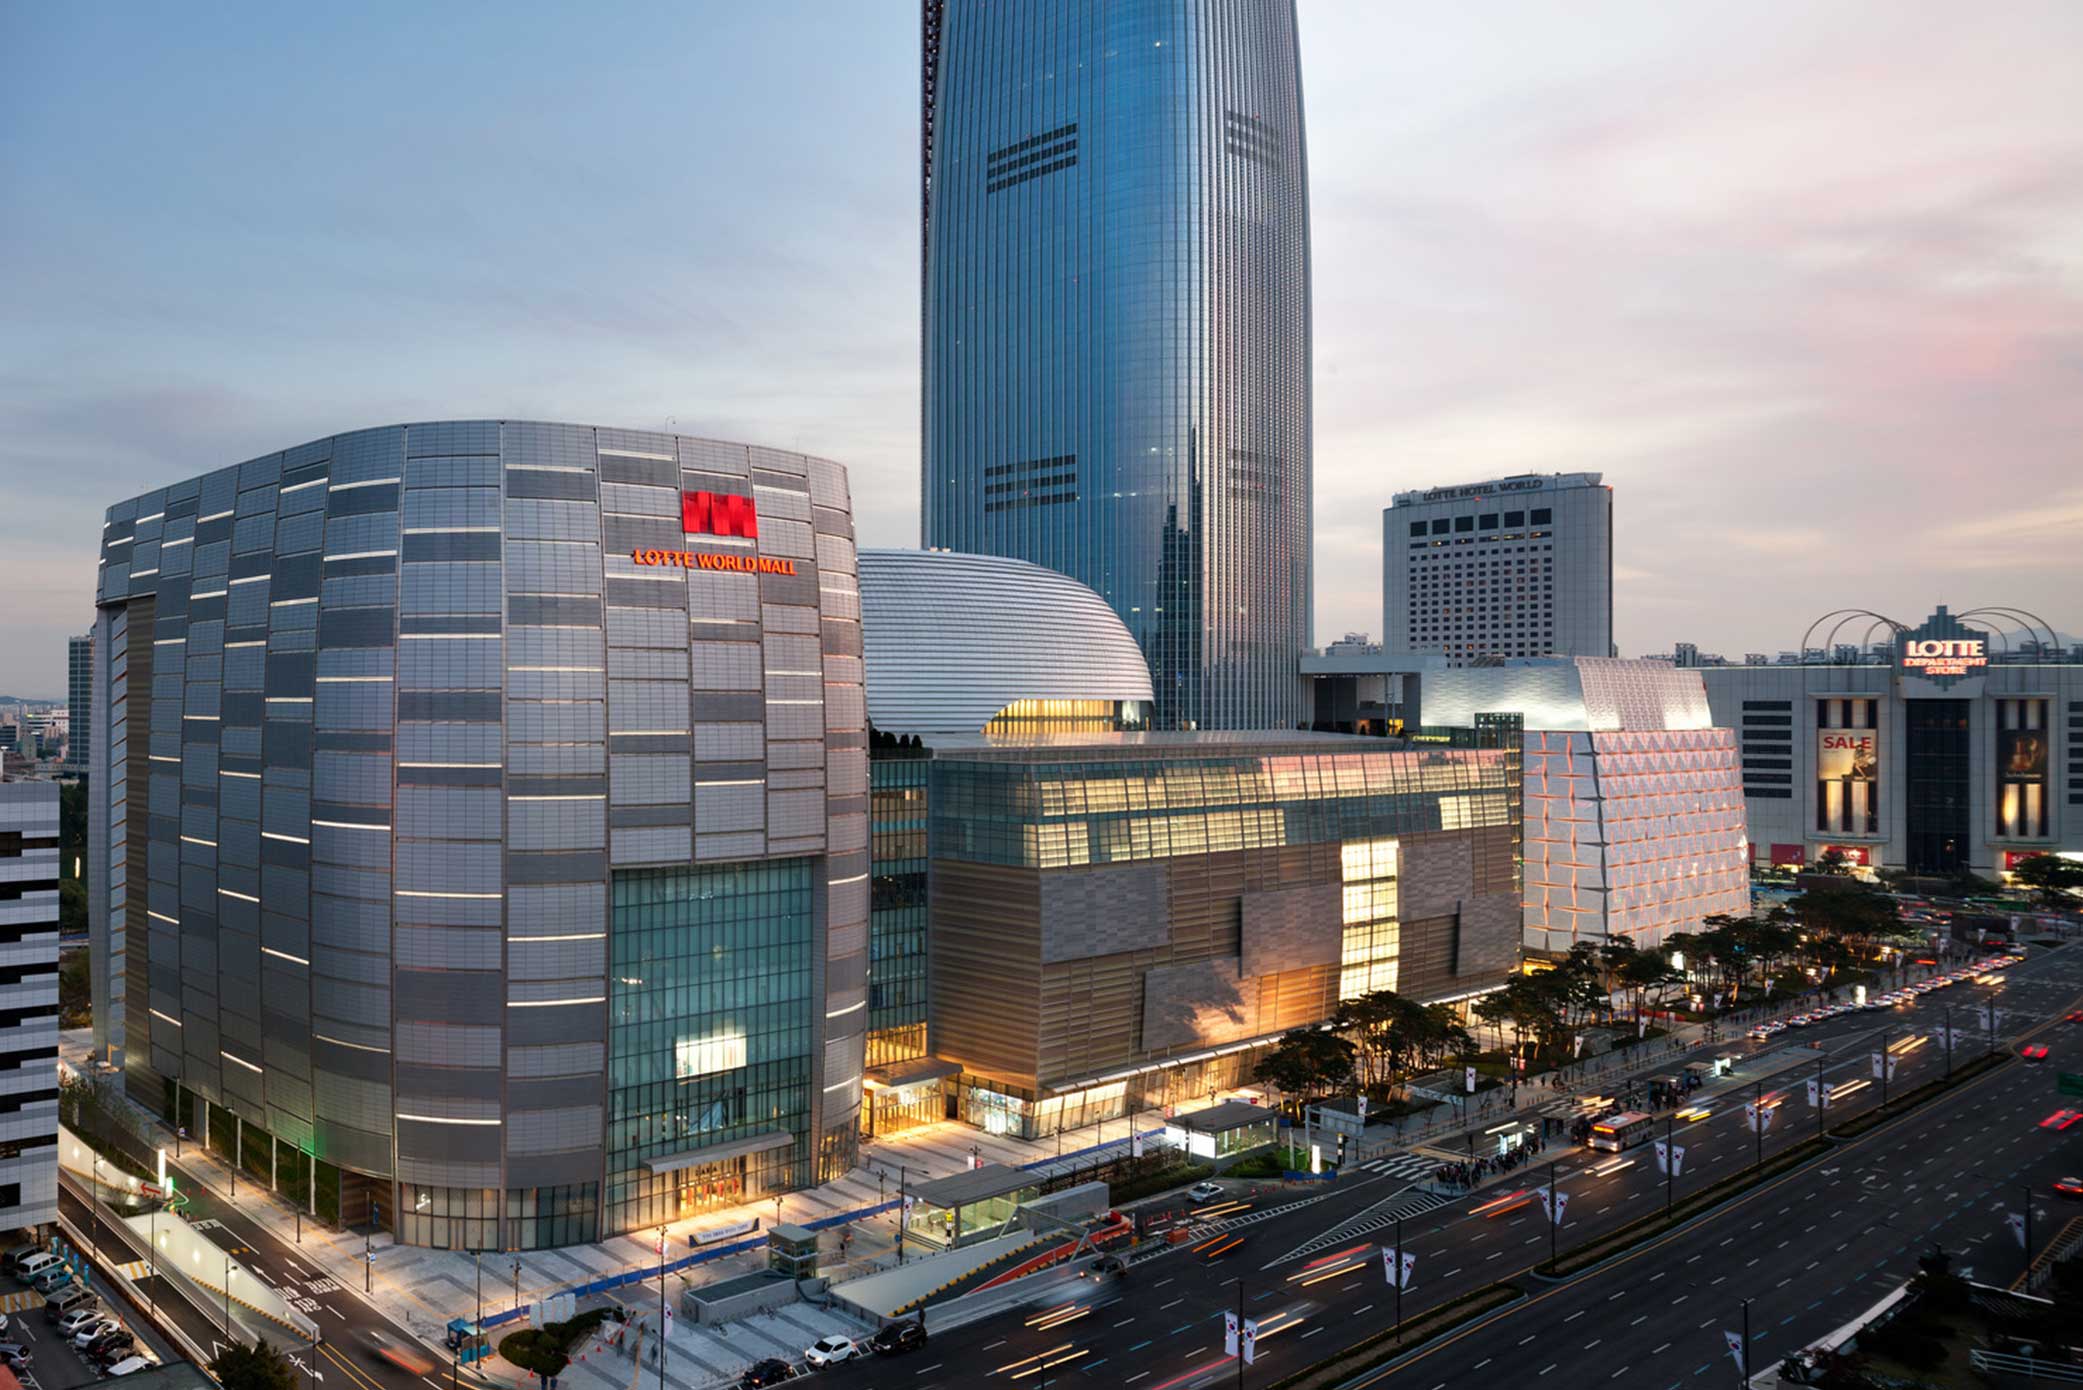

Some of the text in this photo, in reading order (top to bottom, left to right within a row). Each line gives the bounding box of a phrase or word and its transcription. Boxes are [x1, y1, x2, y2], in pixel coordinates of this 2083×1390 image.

[1424, 479, 1543, 501] LOTTE HOTEL WORLD
[634, 549, 797, 576] LOTTE WORLD MALL
[1906, 640, 1984, 657] LOTTE
[1903, 657, 1988, 667] DEPARTMENT
[1925, 666, 1967, 675] STORE
[1823, 735, 1872, 750] SALE
